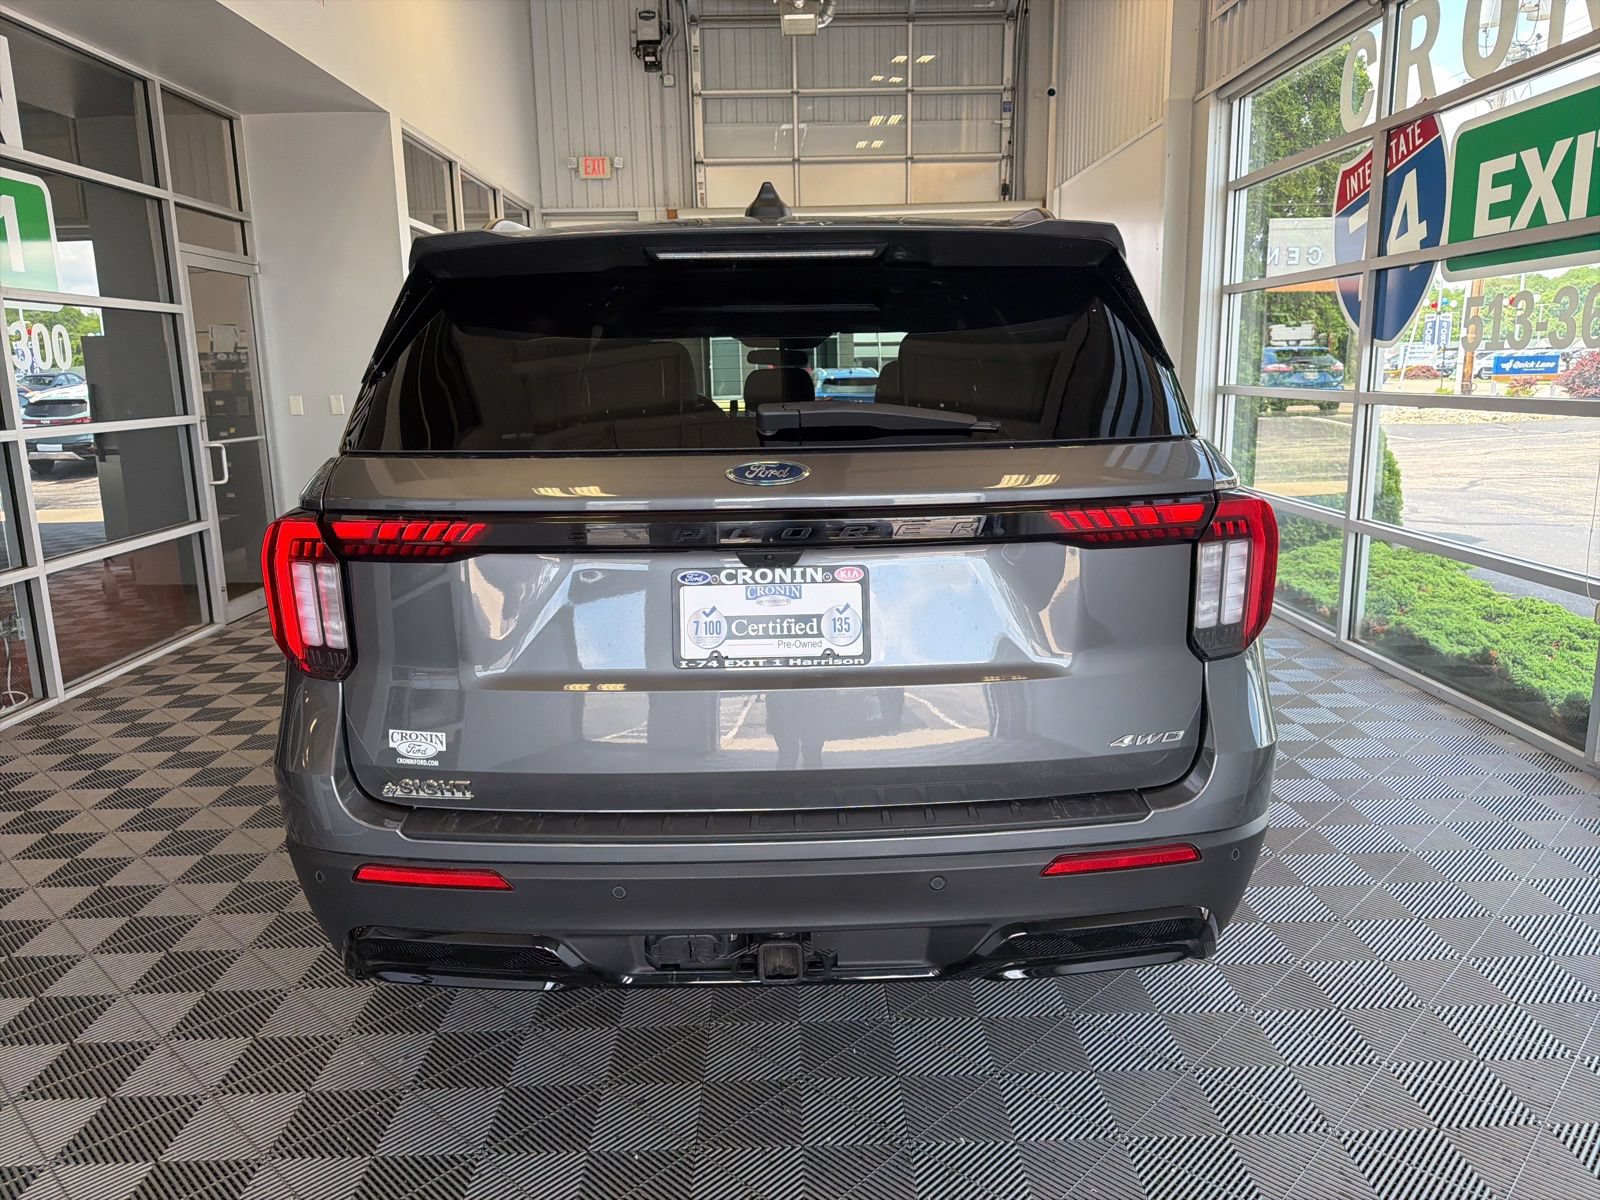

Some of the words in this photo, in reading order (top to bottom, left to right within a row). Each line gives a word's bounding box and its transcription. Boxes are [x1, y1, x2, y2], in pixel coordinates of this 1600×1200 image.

[583, 157, 606, 176] EXIT
[1346, 120, 1423, 200] INTETATE
[1473, 130, 1600, 238] EXI
[8, 320, 72, 370] 300
[1513, 361, 1535, 369] Quick
[744, 463, 790, 478] Ford
[719, 567, 823, 585] CRONIN
[747, 584, 801, 599] CRONIN
[703, 620, 722, 636] 100
[731, 618, 819, 637] Certified
[831, 616, 851, 633] 135
[777, 639, 823, 649] Pre-Owned
[680, 660, 720, 668] I-74
[725, 658, 767, 668] EXIT
[789, 657, 865, 666] Harrison
[390, 731, 445, 748] CRONIN
[1109, 730, 1185, 747] 4WD
[406, 743, 428, 755] Ford
